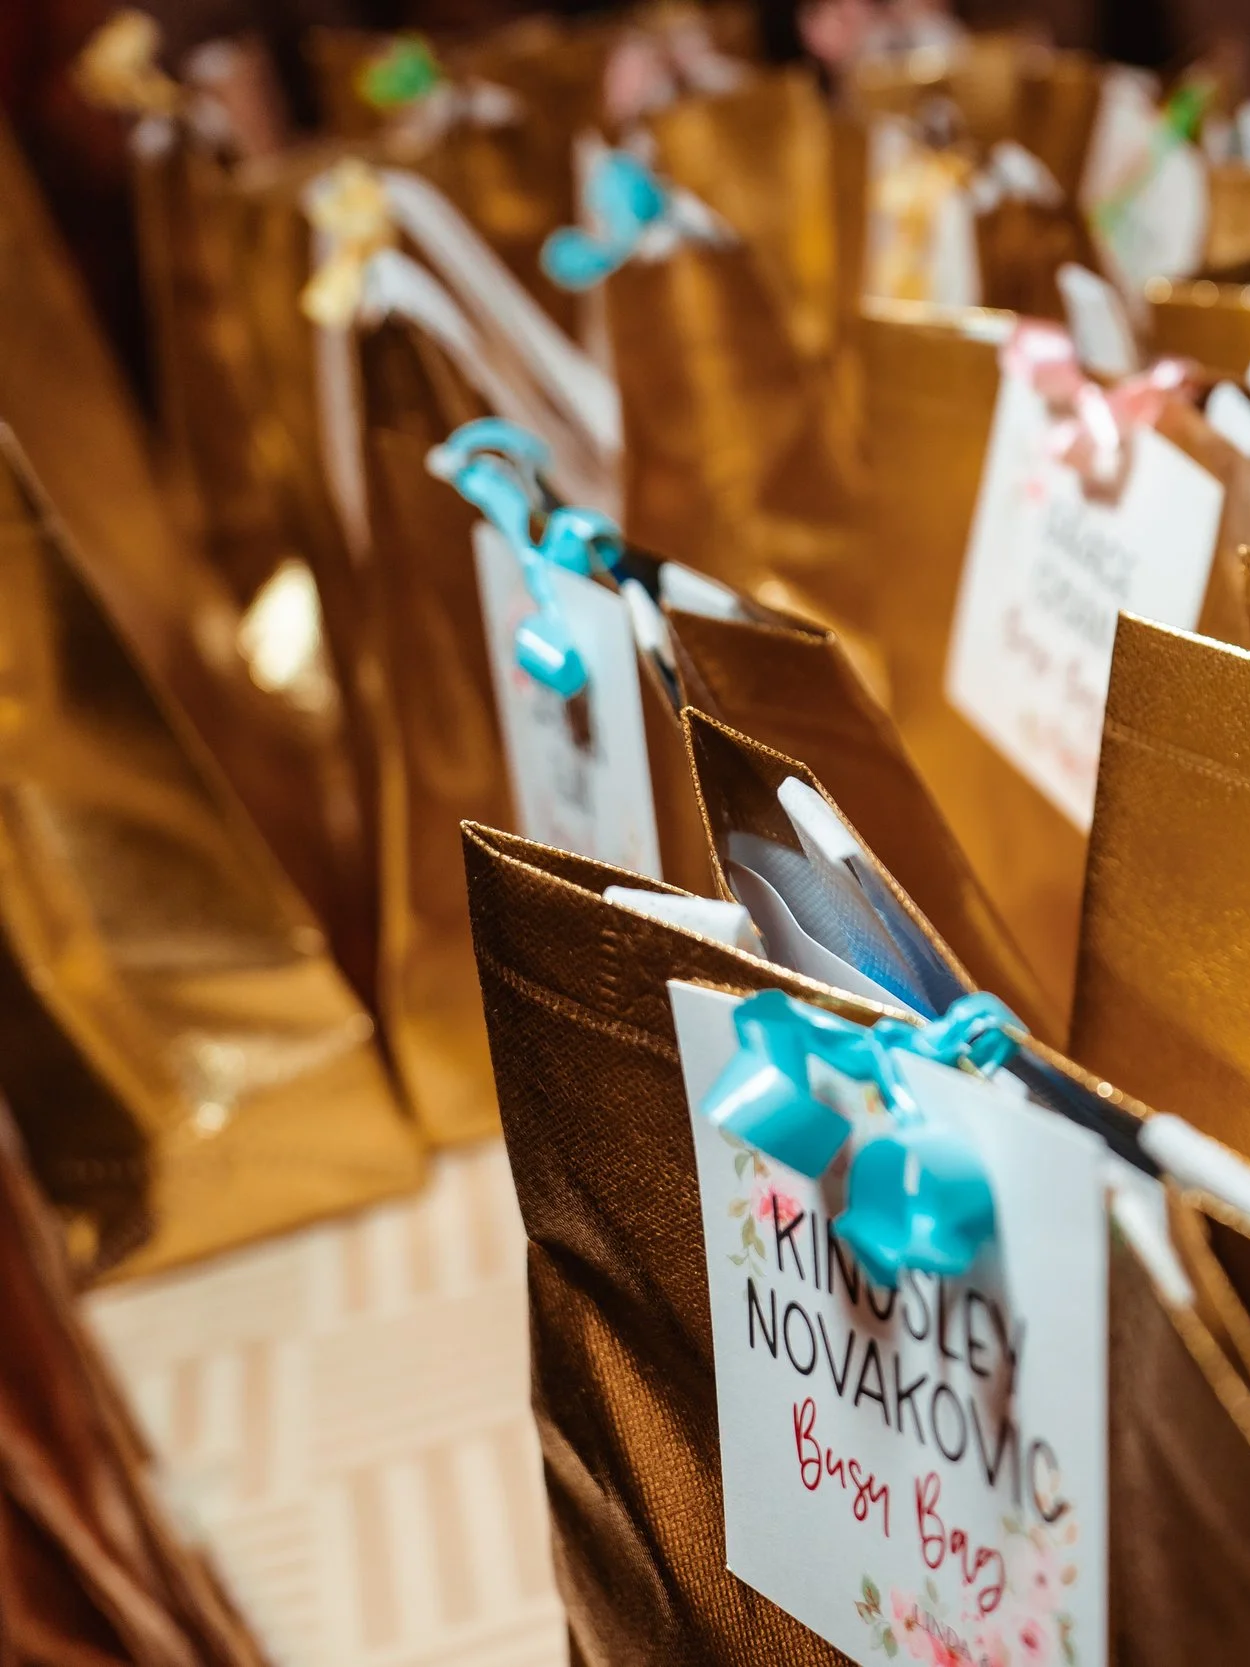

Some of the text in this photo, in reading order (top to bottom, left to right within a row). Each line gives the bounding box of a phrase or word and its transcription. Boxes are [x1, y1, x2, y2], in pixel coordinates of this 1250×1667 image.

[746, 1276, 1070, 1524] NOVAKOVIC
[792, 1396, 1006, 1614] Busy Bag
